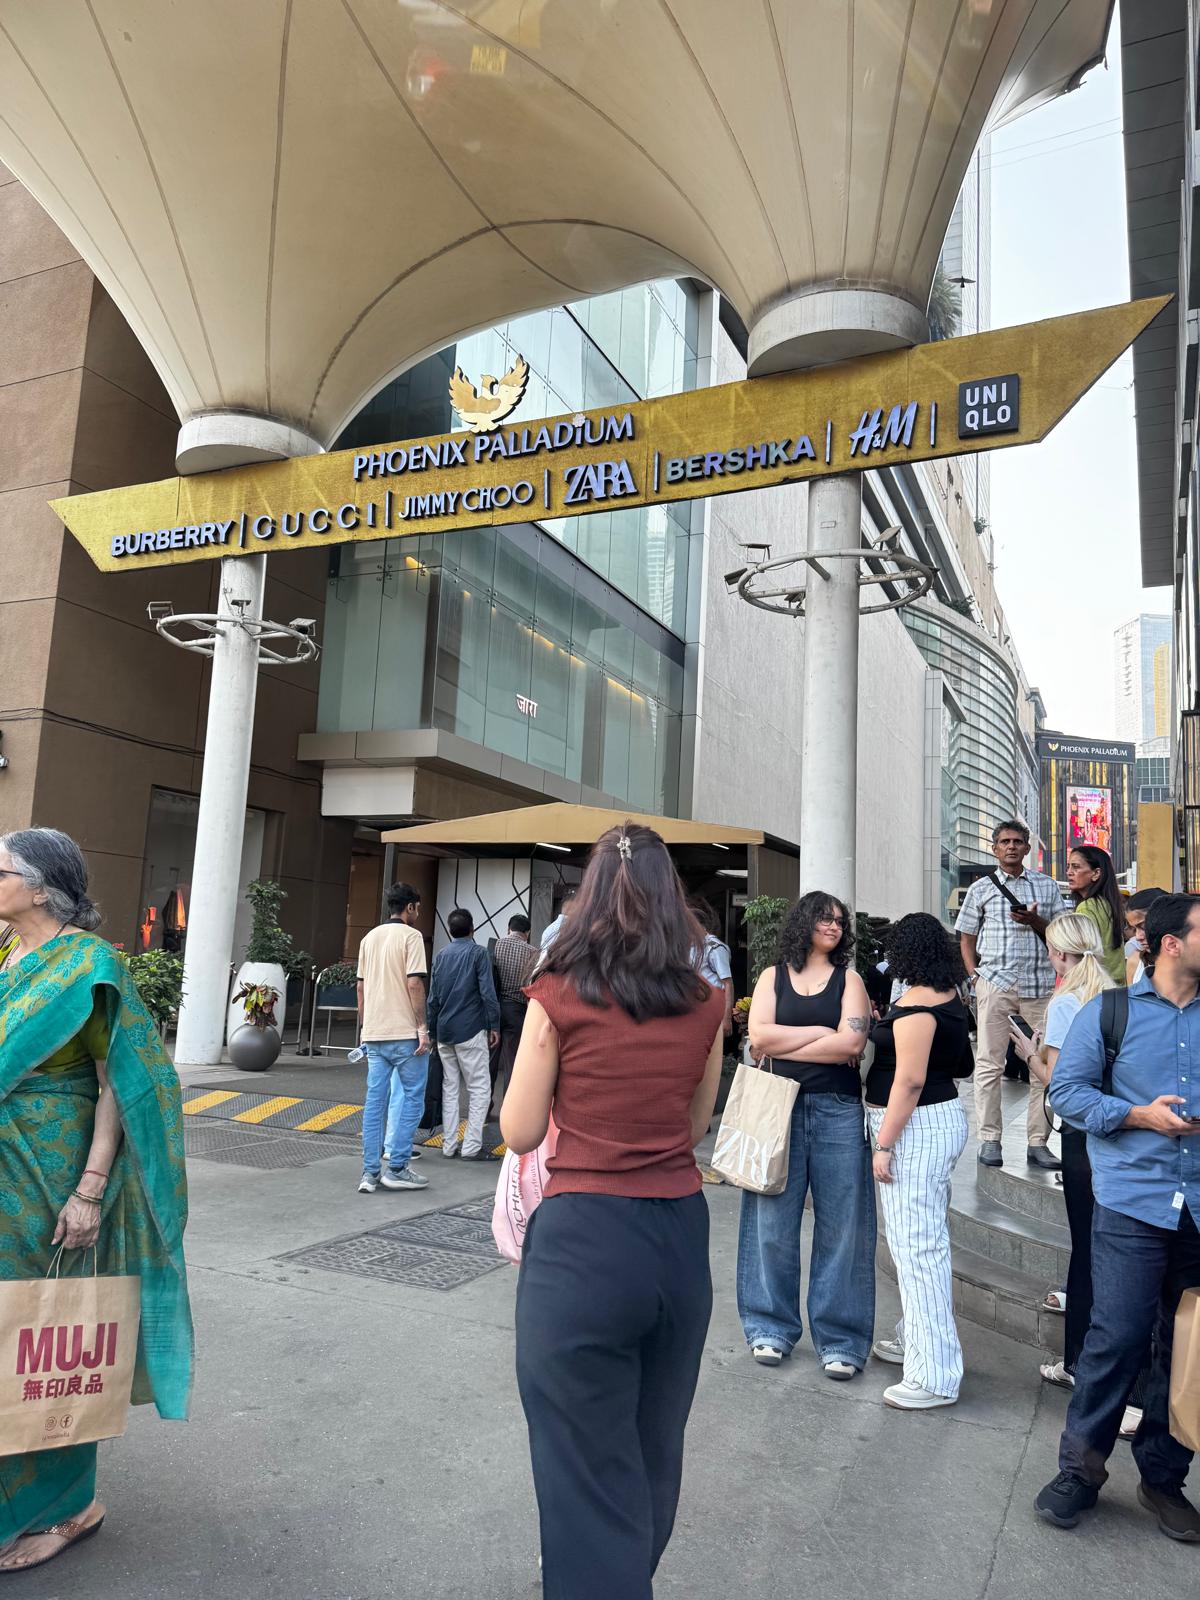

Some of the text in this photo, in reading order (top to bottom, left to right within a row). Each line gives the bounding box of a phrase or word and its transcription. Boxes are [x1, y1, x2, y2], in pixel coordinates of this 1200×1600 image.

[965, 382, 1007, 406] UNI
[965, 404, 1011, 430] QLO
[353, 438, 469, 481] PHOENIX
[111, 400, 918, 557] BURBERRY GUCCI JIMMY CHOO ZARA BERSHKA H&M
[1060, 745, 1090, 755] PHOENIX
[16, 1322, 118, 1375] MUJI
[22, 1373, 104, 1402] 無印良品
